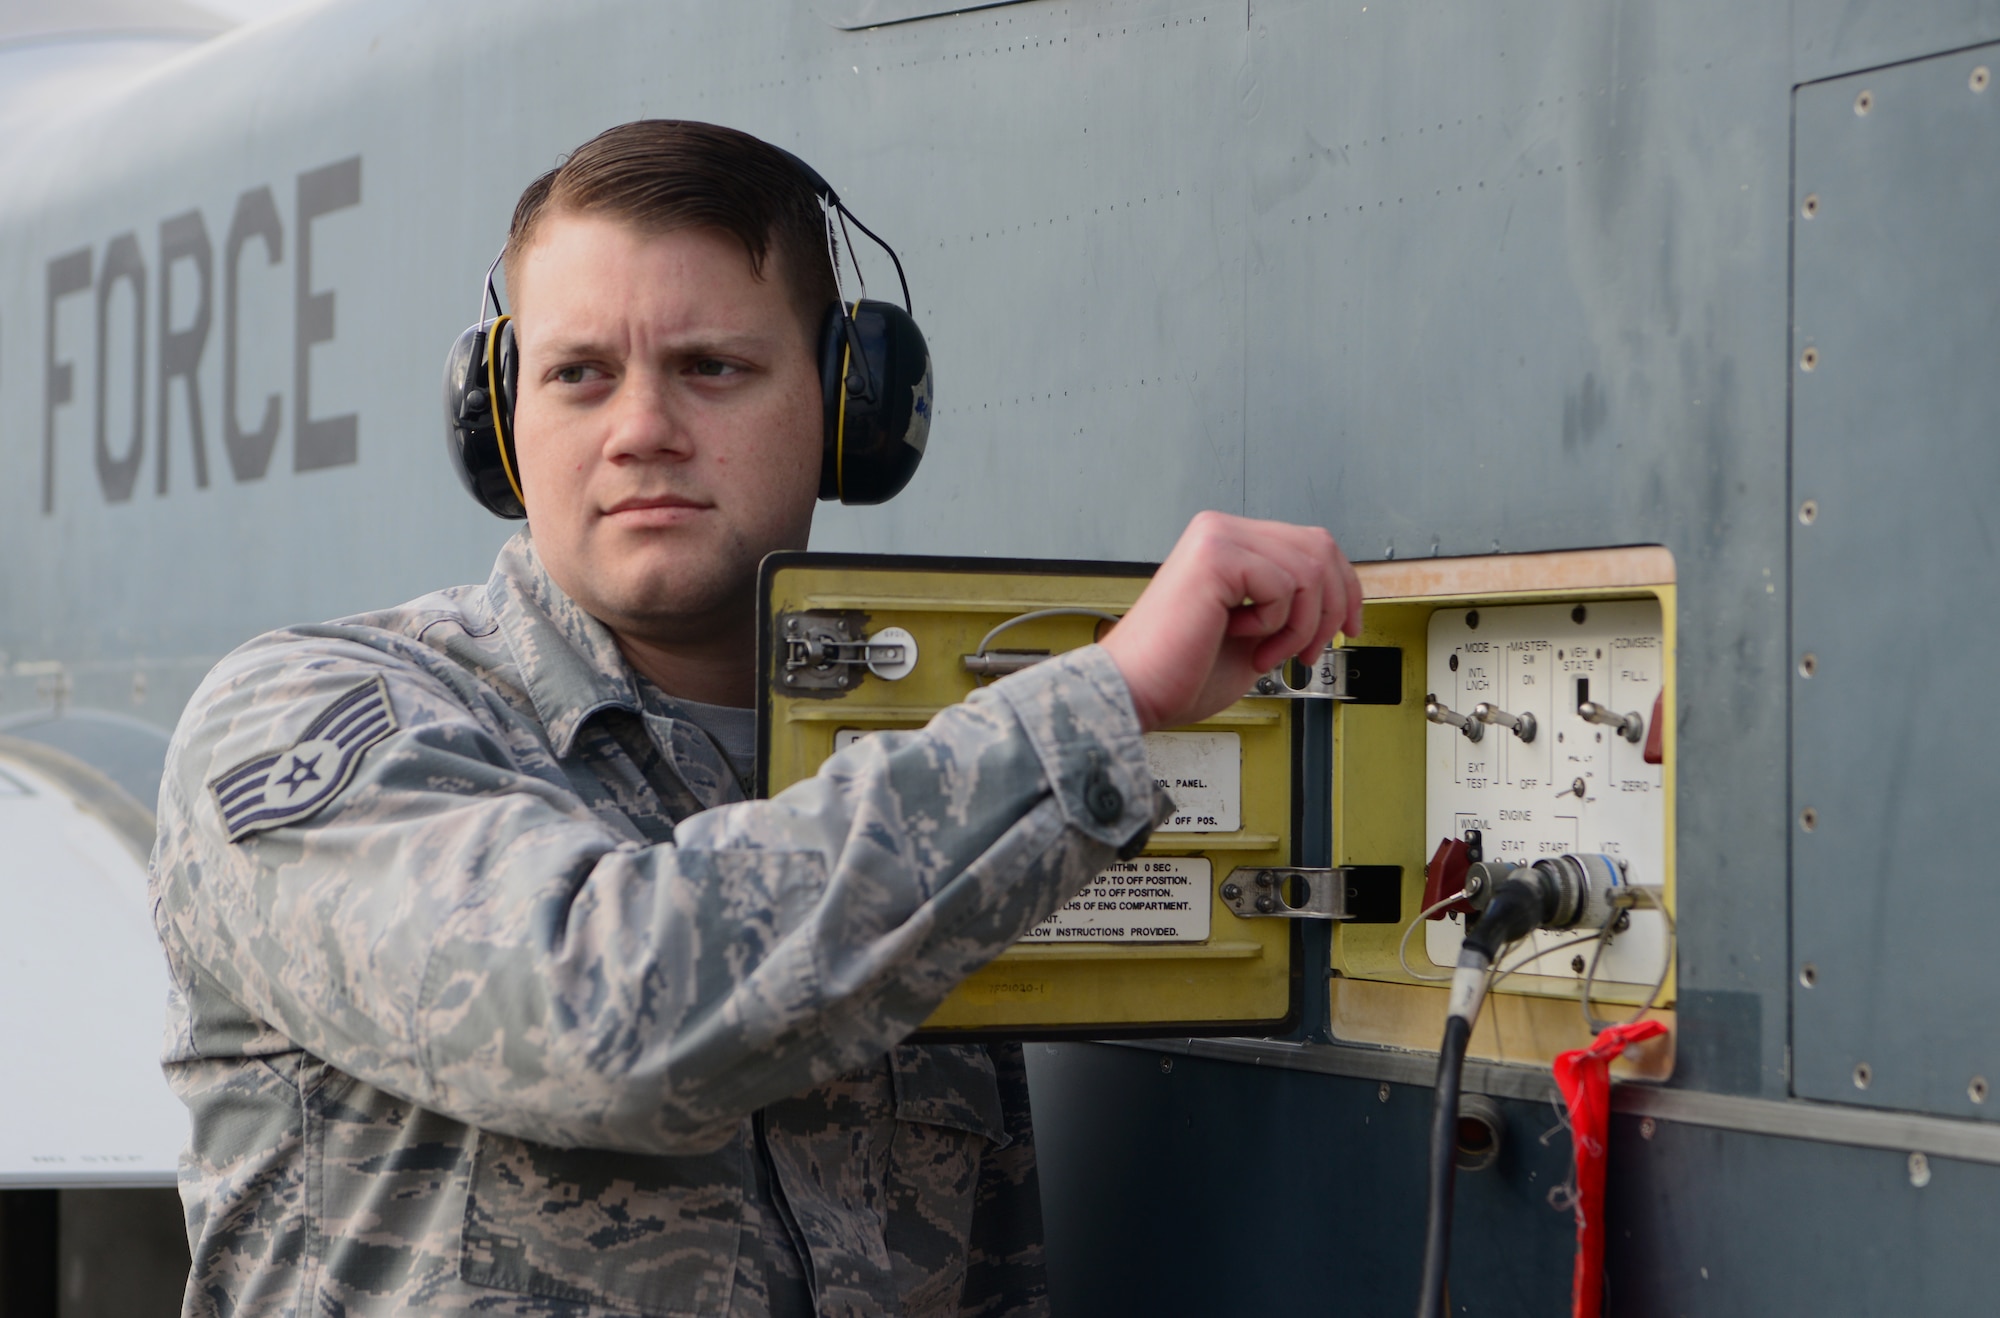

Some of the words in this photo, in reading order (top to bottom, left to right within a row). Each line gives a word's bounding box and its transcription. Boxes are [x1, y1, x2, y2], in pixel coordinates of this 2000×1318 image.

[42, 154, 363, 517] FORCE
[1465, 642, 1489, 653] MODE
[1509, 640, 1549, 652] MASTER
[1614, 637, 1656, 649] COMSEC
[1569, 647, 1588, 658] VEH
[1522, 654, 1535, 664] SW
[1563, 660, 1595, 671] STATE
[1468, 667, 1487, 678] INTL
[1621, 670, 1648, 682] FILL
[1522, 674, 1535, 685] ON
[1465, 680, 1489, 691] LNCH
[1467, 762, 1485, 773] EXT
[1176, 779, 1208, 788] PANEL.
[1466, 778, 1488, 789] TEST
[1520, 779, 1538, 789] OFF
[1621, 780, 1649, 792] ZERO
[1499, 809, 1532, 821] ENGINE
[1175, 816, 1192, 825] OFF
[1196, 816, 1218, 826] POS.
[1501, 840, 1525, 852] STAT
[1539, 842, 1569, 853] START
[1600, 842, 1620, 854] VTC
[1112, 876, 1125, 886] TO
[1126, 876, 1144, 886] OFF
[1146, 876, 1192, 886] POSITION.
[1092, 889, 1107, 899] TO
[1109, 889, 1127, 899] OFF
[1128, 889, 1174, 899] POSITION.
[1083, 902, 1096, 911] OF
[1098, 902, 1117, 911] ENG
[1119, 902, 1192, 911] COMPARTMENT.
[1056, 928, 1125, 937] INSTRUCTIONS
[1131, 928, 1179, 937] PROVIDED.
